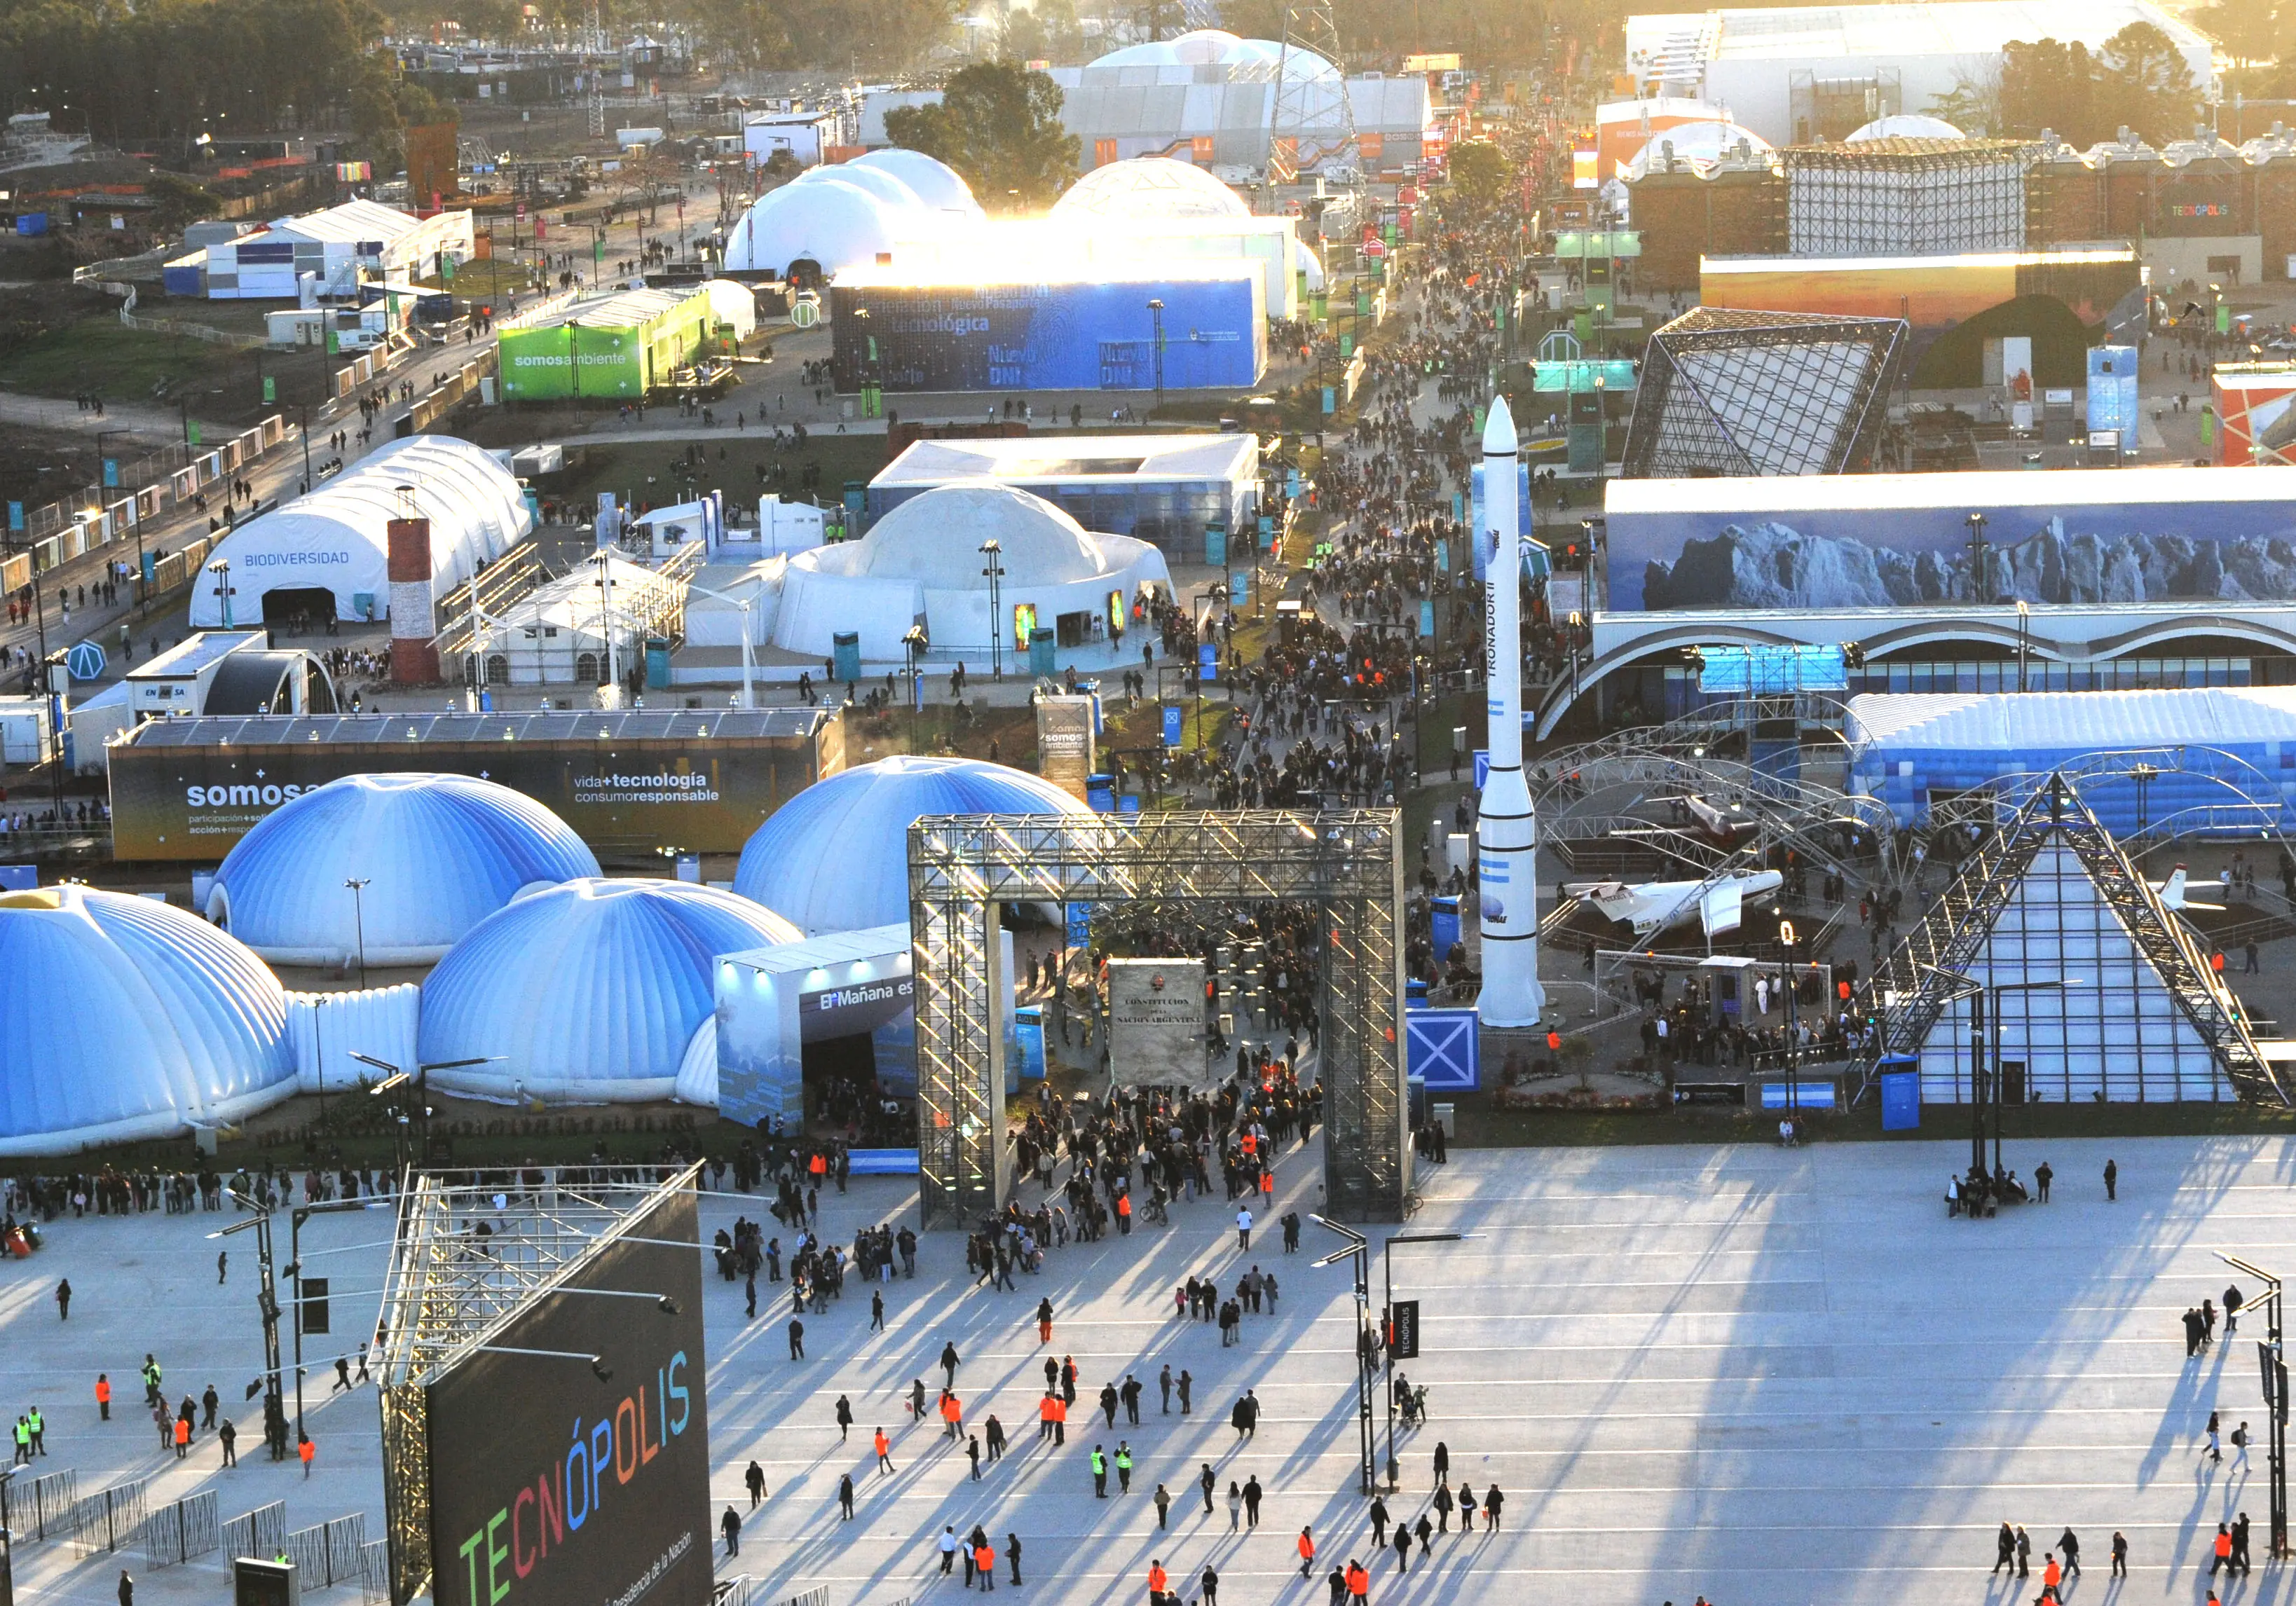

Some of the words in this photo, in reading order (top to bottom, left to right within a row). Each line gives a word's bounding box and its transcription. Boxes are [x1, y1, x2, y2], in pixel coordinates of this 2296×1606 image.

[245, 552, 349, 567] BIODIVERSIDAD
[1487, 593, 1496, 678] TRONADOR
[1045, 734, 1083, 742] somos
[820, 994, 833, 1010] El
[838, 986, 894, 1007] Mañana
[898, 982, 914, 996] es
[1401, 1307, 1409, 1354] TECNÓPOLIS
[460, 1351, 690, 1606] TECNÓPOLIS
[652, 1560, 660, 1579] de
[662, 1553, 668, 1570] la
[669, 1531, 691, 1563] Nación
